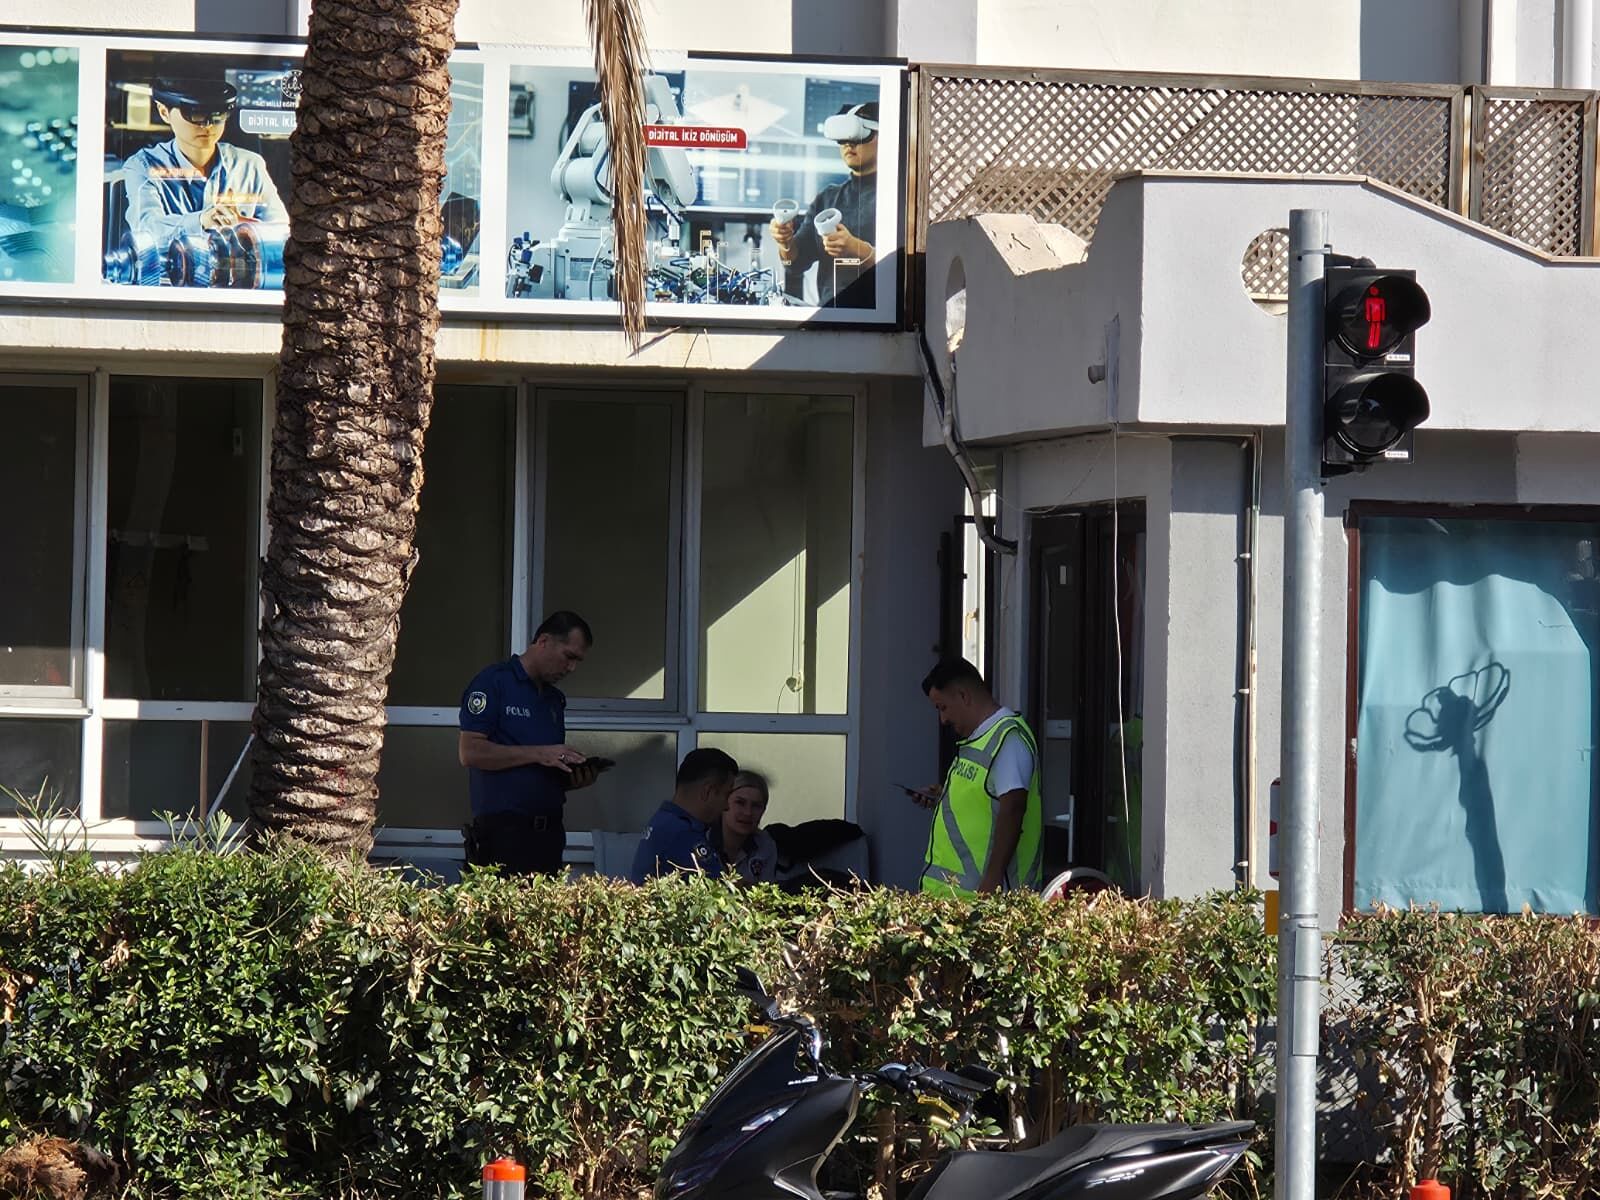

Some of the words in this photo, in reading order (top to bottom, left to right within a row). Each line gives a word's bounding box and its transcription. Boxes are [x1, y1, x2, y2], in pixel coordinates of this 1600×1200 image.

[649, 128, 679, 141] DİJİTAL
[682, 128, 698, 142] İKİZ
[700, 130, 738, 143] DÖNÜŞÜM
